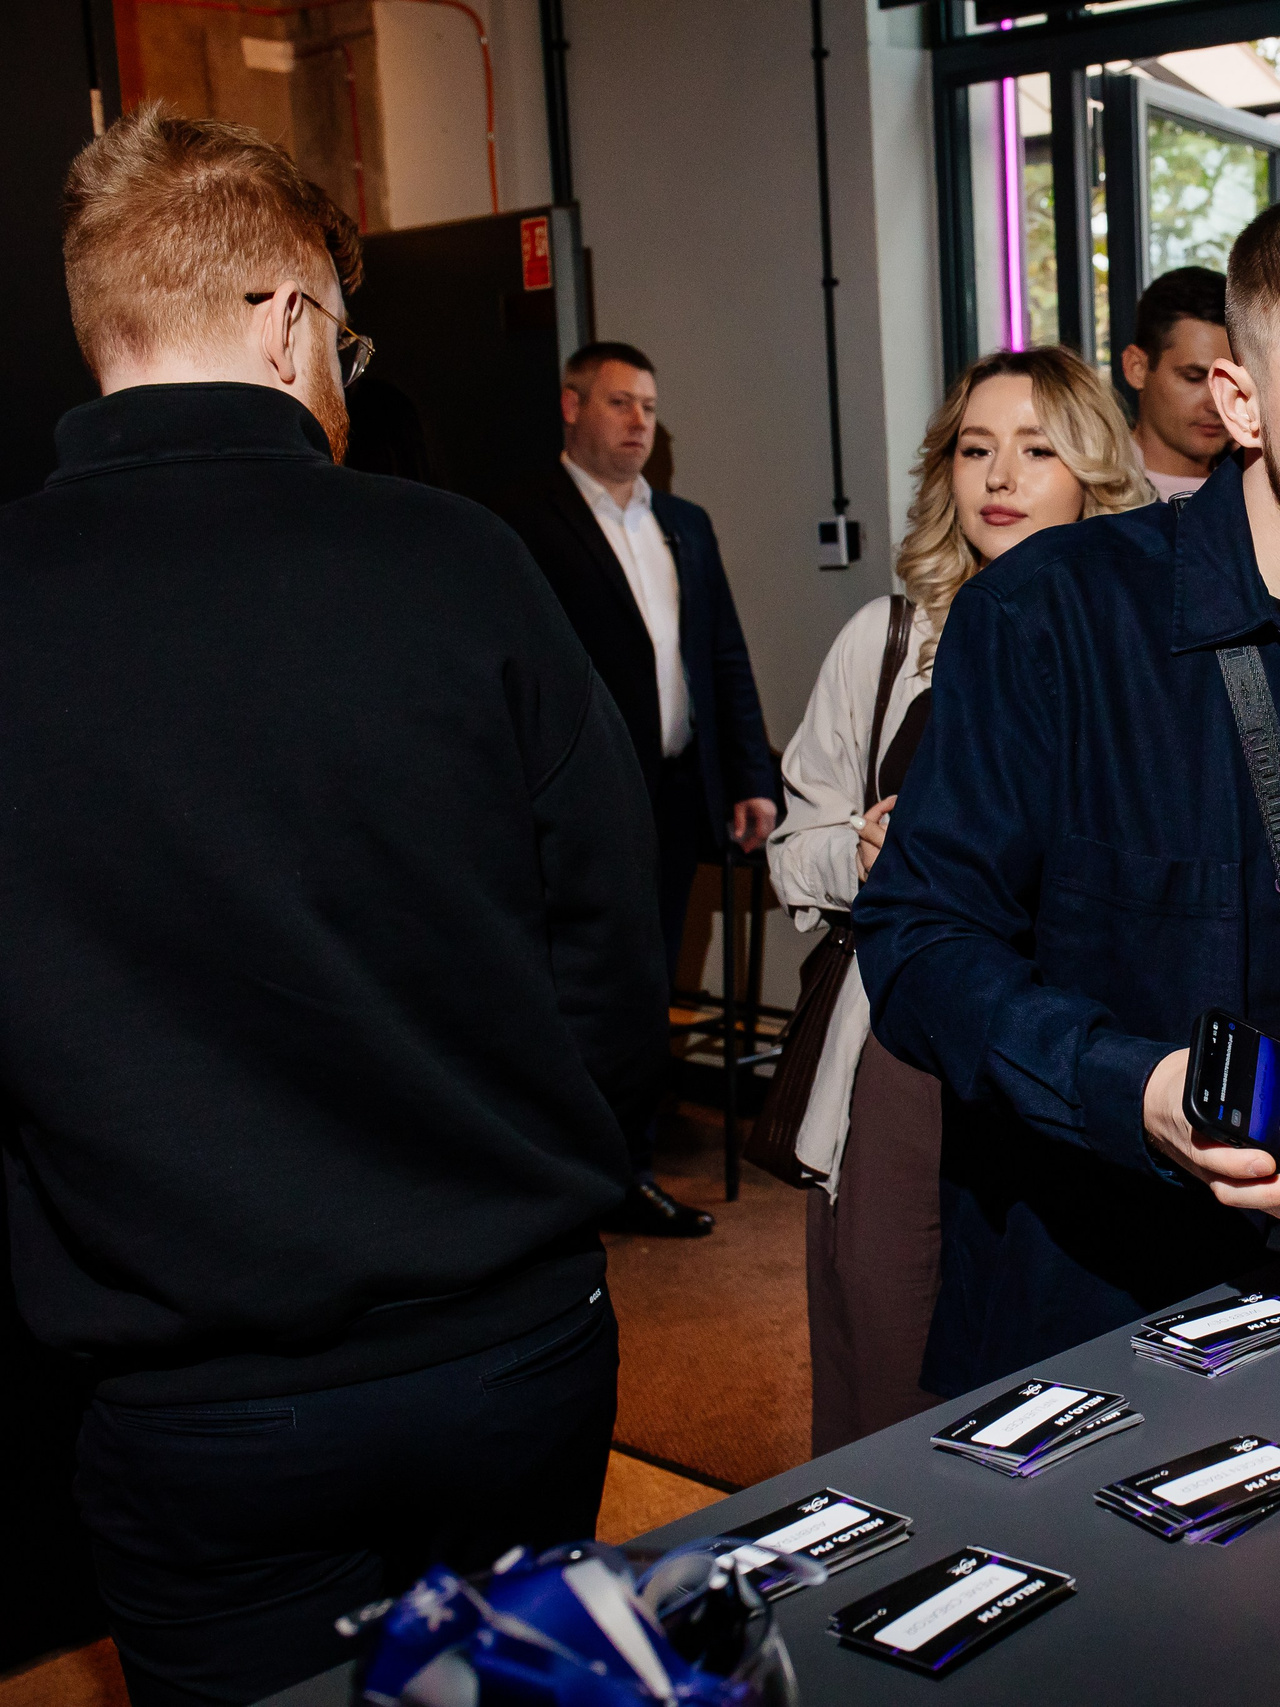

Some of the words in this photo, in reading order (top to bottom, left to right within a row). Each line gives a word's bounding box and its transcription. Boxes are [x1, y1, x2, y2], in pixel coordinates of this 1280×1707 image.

[1247, 1321, 1266, 1331] I'M
[1001, 1397, 1058, 1434] INFLUENCER
[1068, 1394, 1106, 1418] HELLO,
[1053, 1413, 1072, 1427] I'M
[1179, 1470, 1228, 1494] TRADER
[1243, 1478, 1266, 1492] I'M
[832, 1517, 885, 1546] HELLO,
[809, 1540, 834, 1556] I'M
[996, 1578, 1046, 1612] HELLO,
[903, 1594, 963, 1637] CREATOR
[976, 1605, 1001, 1624] I'M
